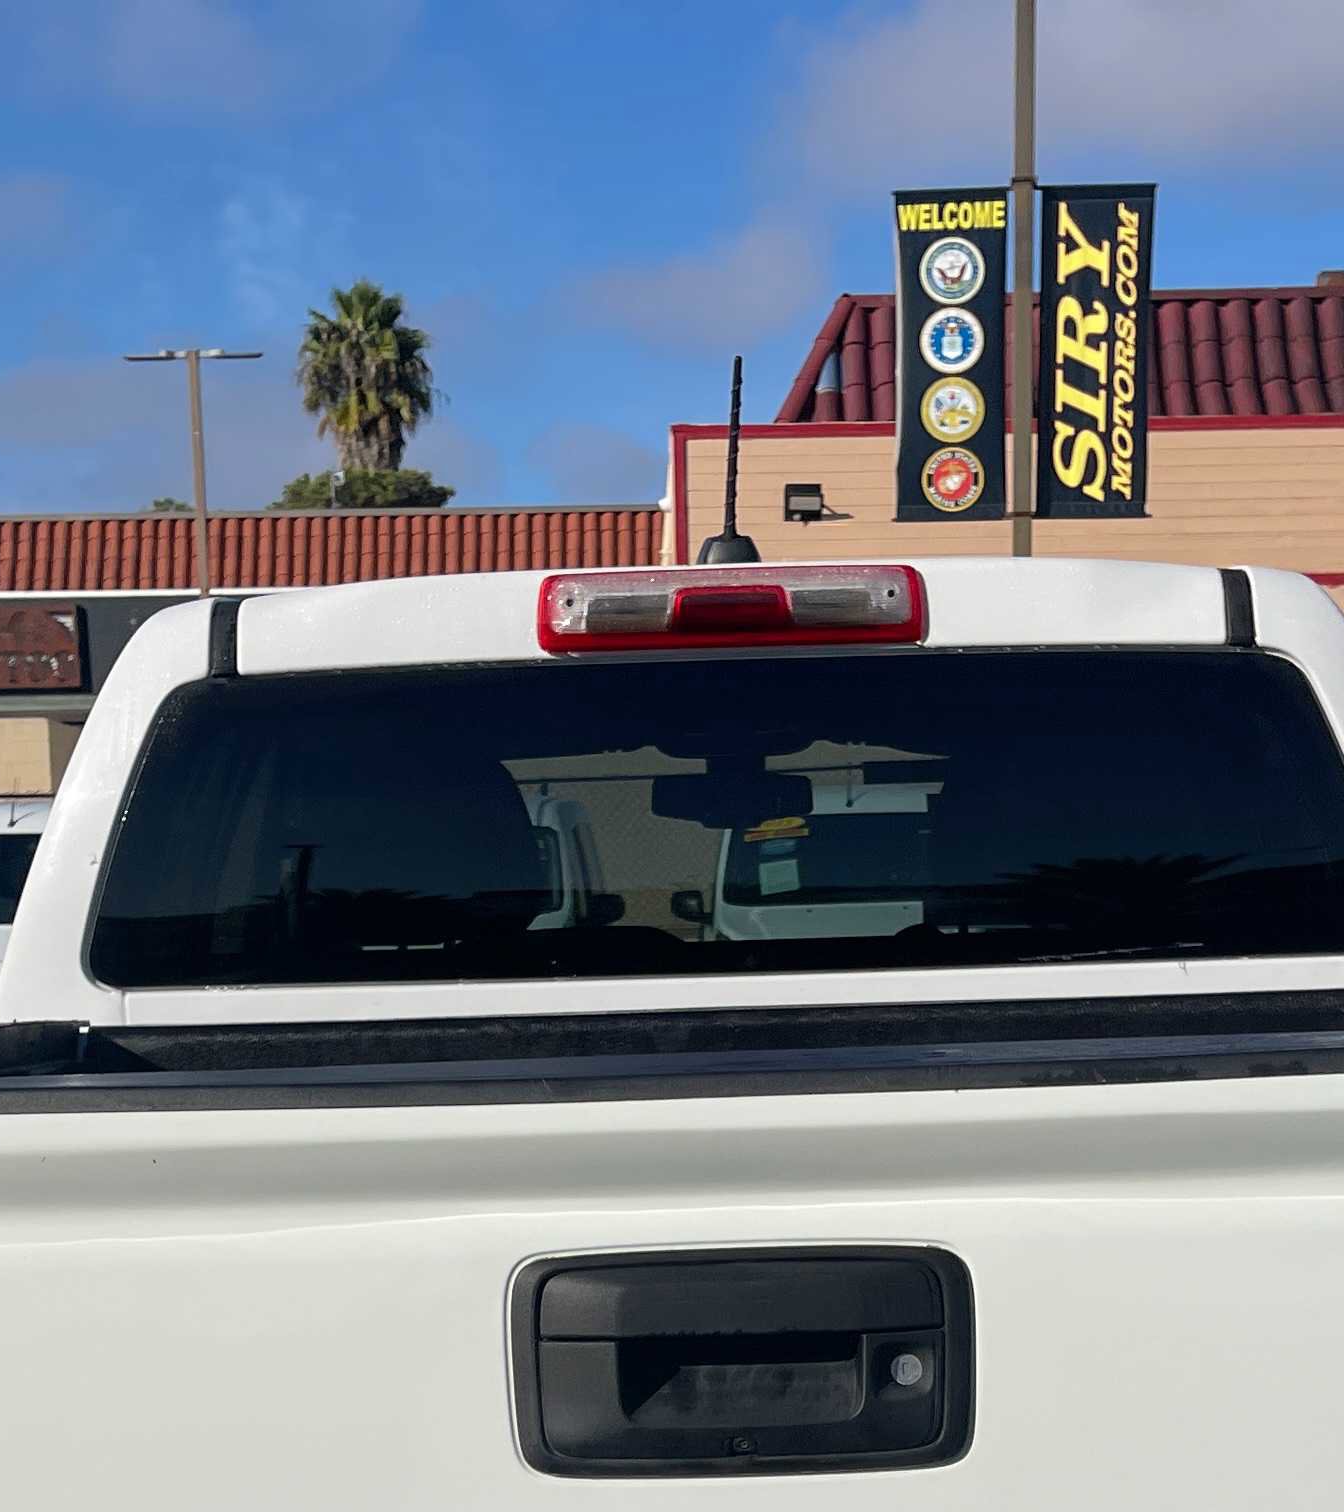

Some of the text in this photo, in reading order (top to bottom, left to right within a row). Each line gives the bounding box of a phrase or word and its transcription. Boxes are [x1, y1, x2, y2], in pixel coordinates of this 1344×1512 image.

[897, 200, 1006, 232] WELCOME
[1052, 201, 1111, 502] SIRY
[1111, 202, 1140, 501] MOTORS.COM
